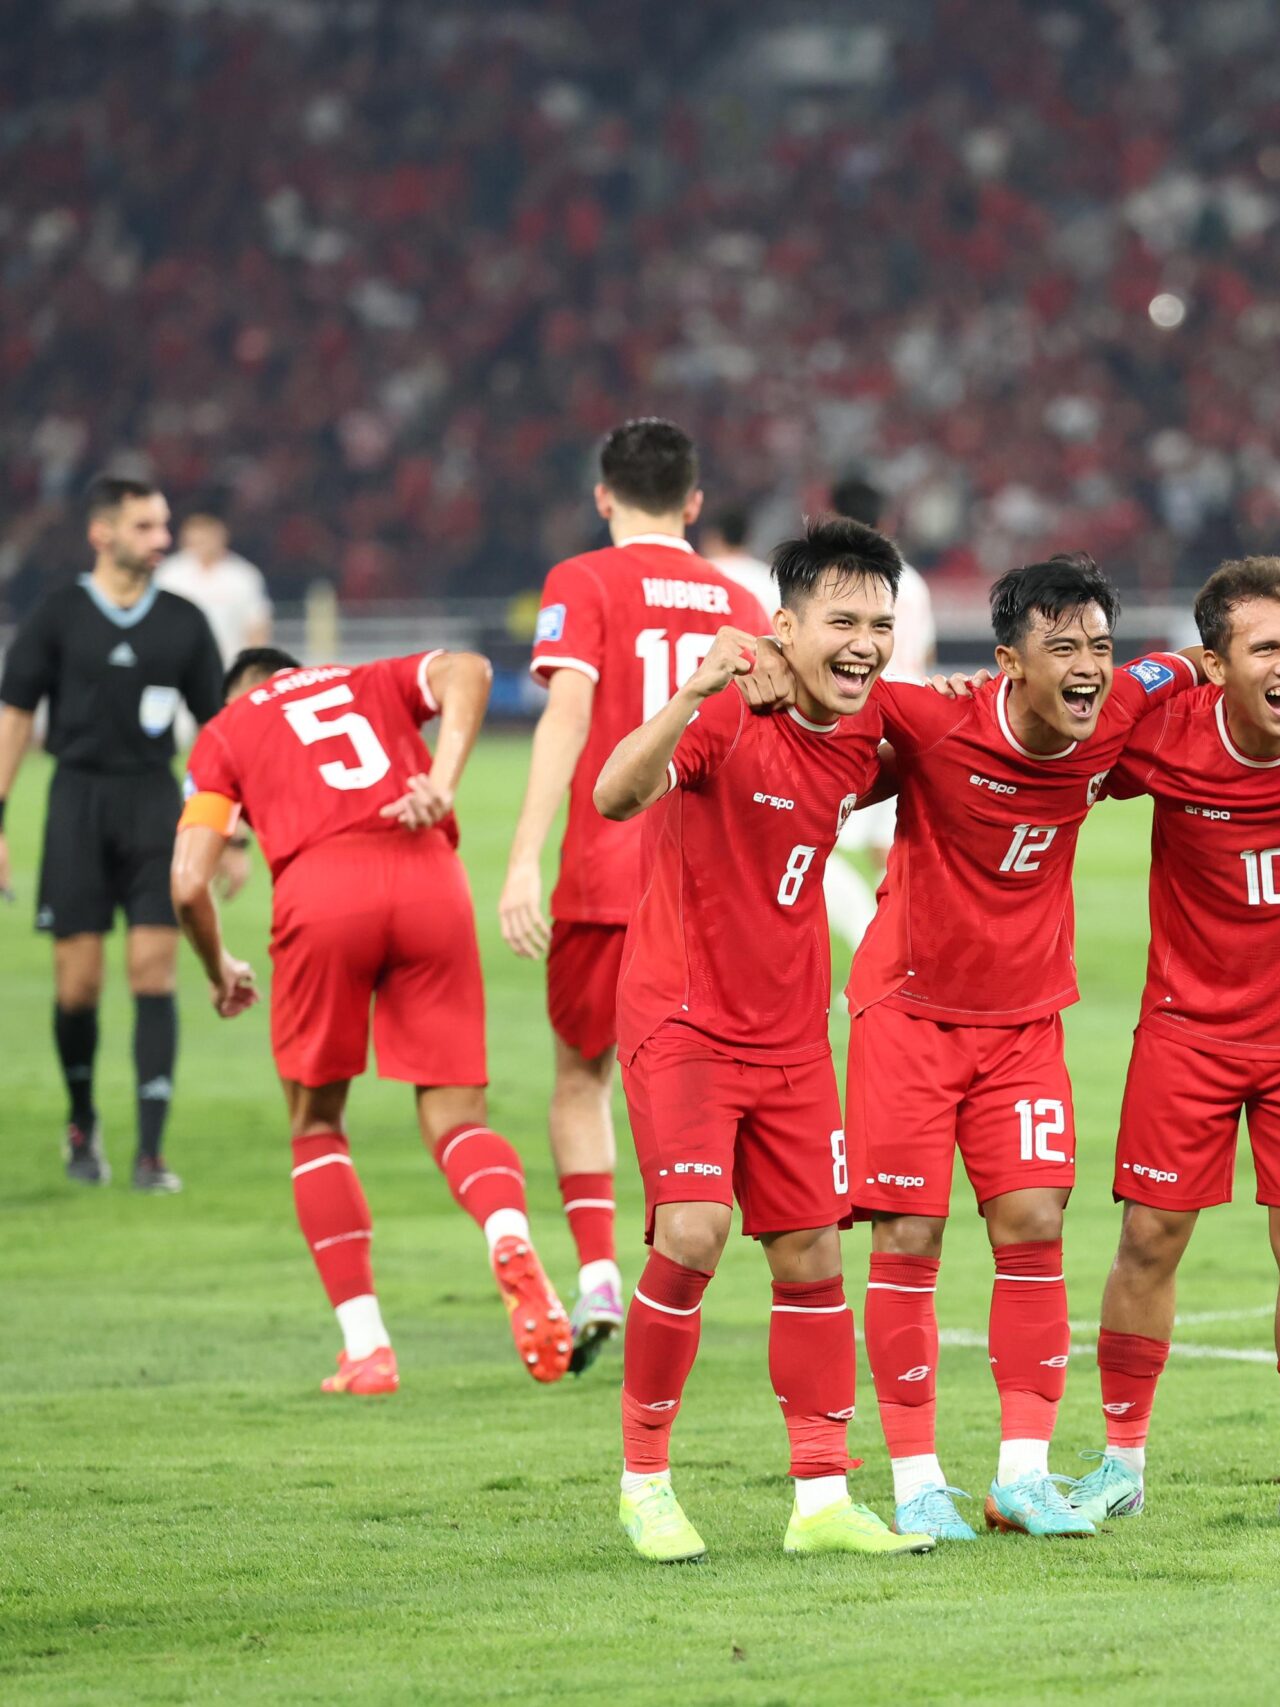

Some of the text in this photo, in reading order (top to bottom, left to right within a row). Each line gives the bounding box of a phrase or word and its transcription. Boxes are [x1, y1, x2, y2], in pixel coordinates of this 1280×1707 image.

[281, 684, 392, 790] 5
[969, 774, 1017, 795] erspo
[753, 792, 795, 810] erspo
[1185, 805, 1231, 820] erspo
[999, 823, 1058, 873] 12
[777, 844, 818, 906] 8
[1014, 1098, 1066, 1163] 12
[674, 1162, 722, 1176] erspo
[830, 1129, 849, 1195] 8
[877, 1172, 925, 1188] erspo
[1132, 1163, 1178, 1183] erspo
